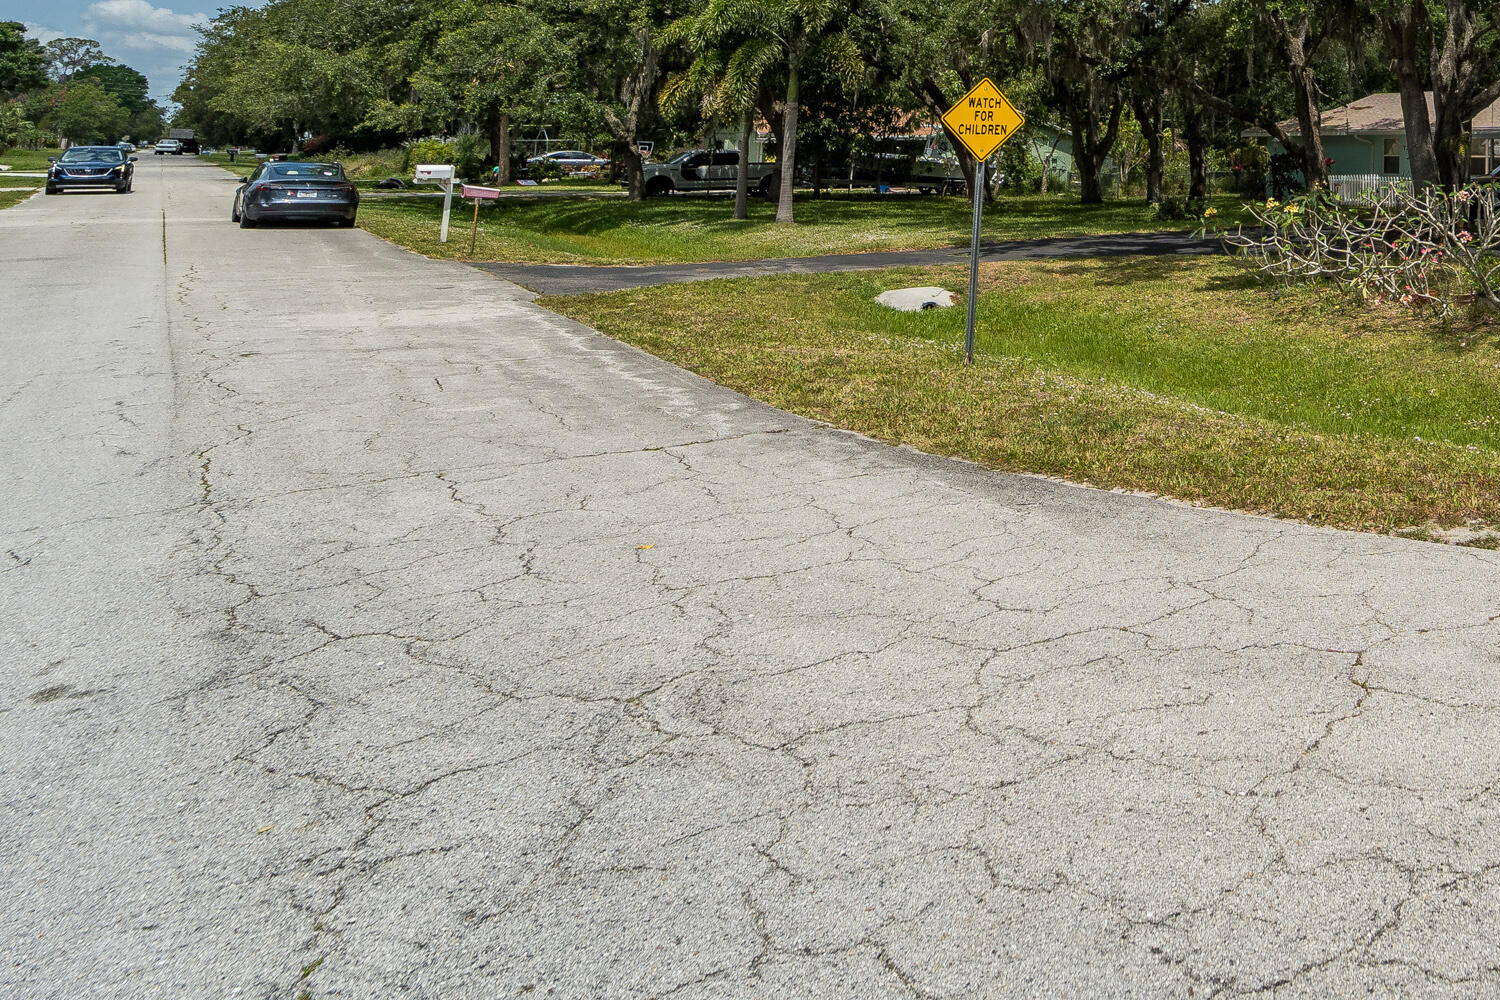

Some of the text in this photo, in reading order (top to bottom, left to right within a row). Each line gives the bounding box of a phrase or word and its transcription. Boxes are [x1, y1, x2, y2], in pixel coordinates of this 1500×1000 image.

[968, 97, 1001, 108] WATCH
[974, 110, 994, 122] FOR
[958, 124, 1008, 136] CHILDREN
